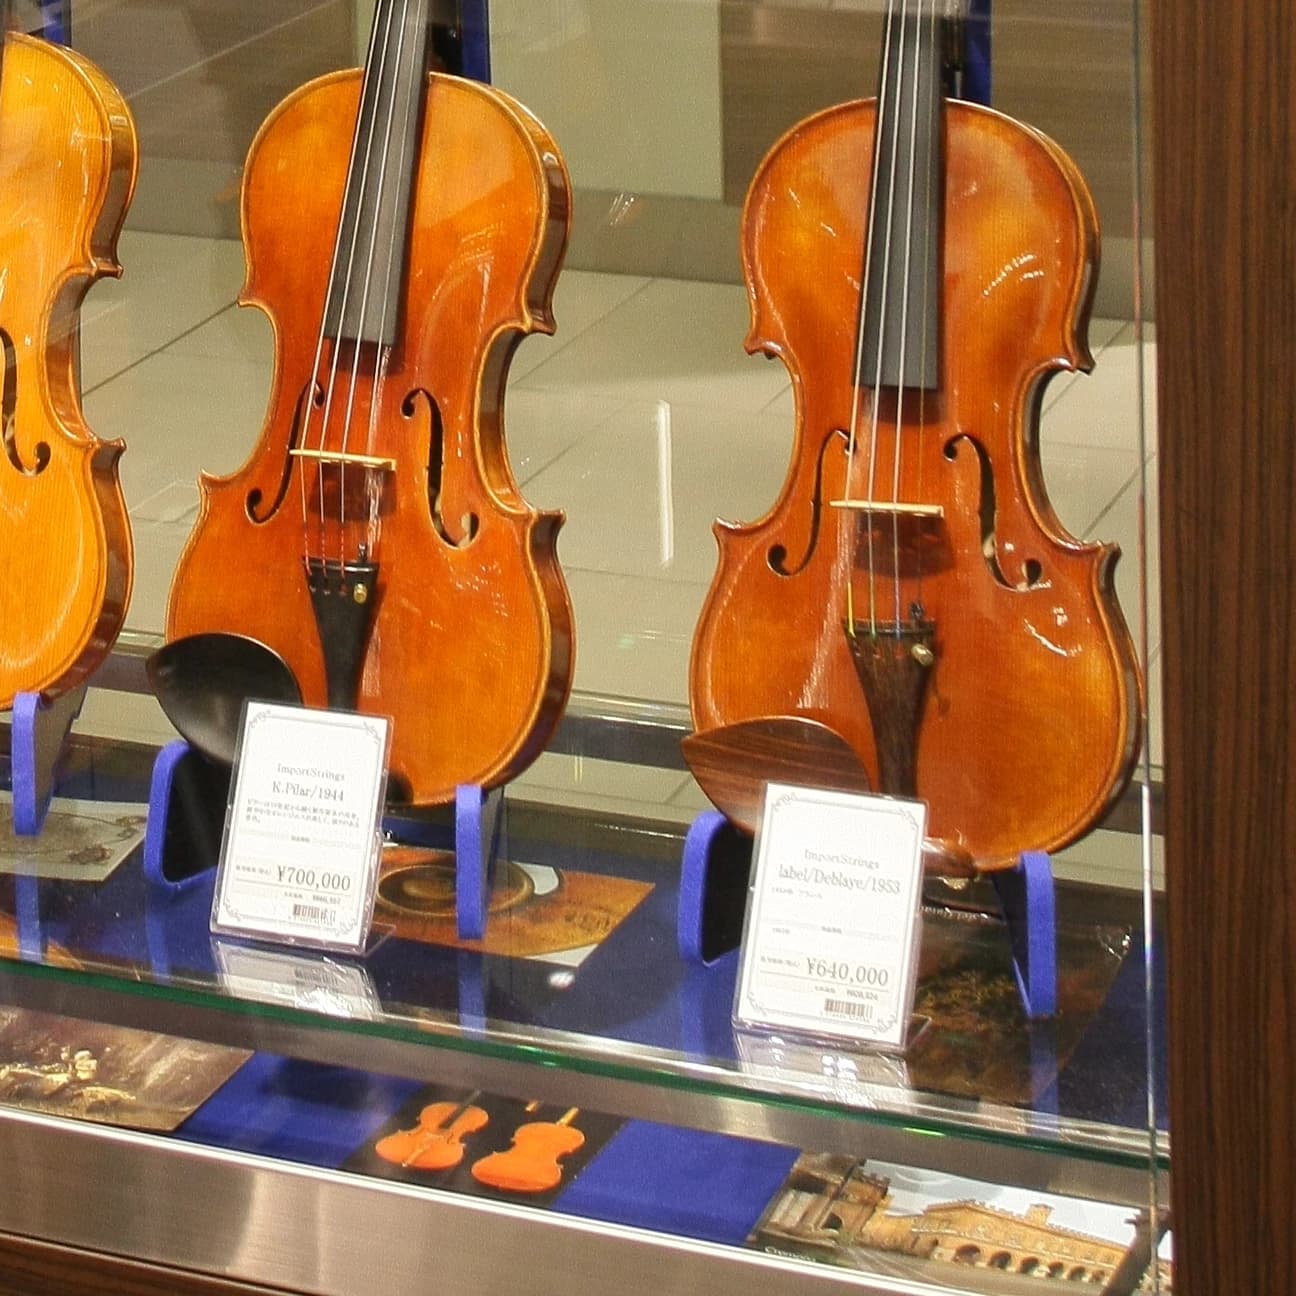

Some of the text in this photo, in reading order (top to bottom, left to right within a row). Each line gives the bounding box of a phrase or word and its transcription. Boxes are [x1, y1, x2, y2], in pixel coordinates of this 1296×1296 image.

[277, 762, 345, 782] ImportStrings
[272, 781, 344, 803] K.Pilar/1944
[277, 864, 351, 891] ¥700,000
[806, 956, 889, 986] ¥640,000
